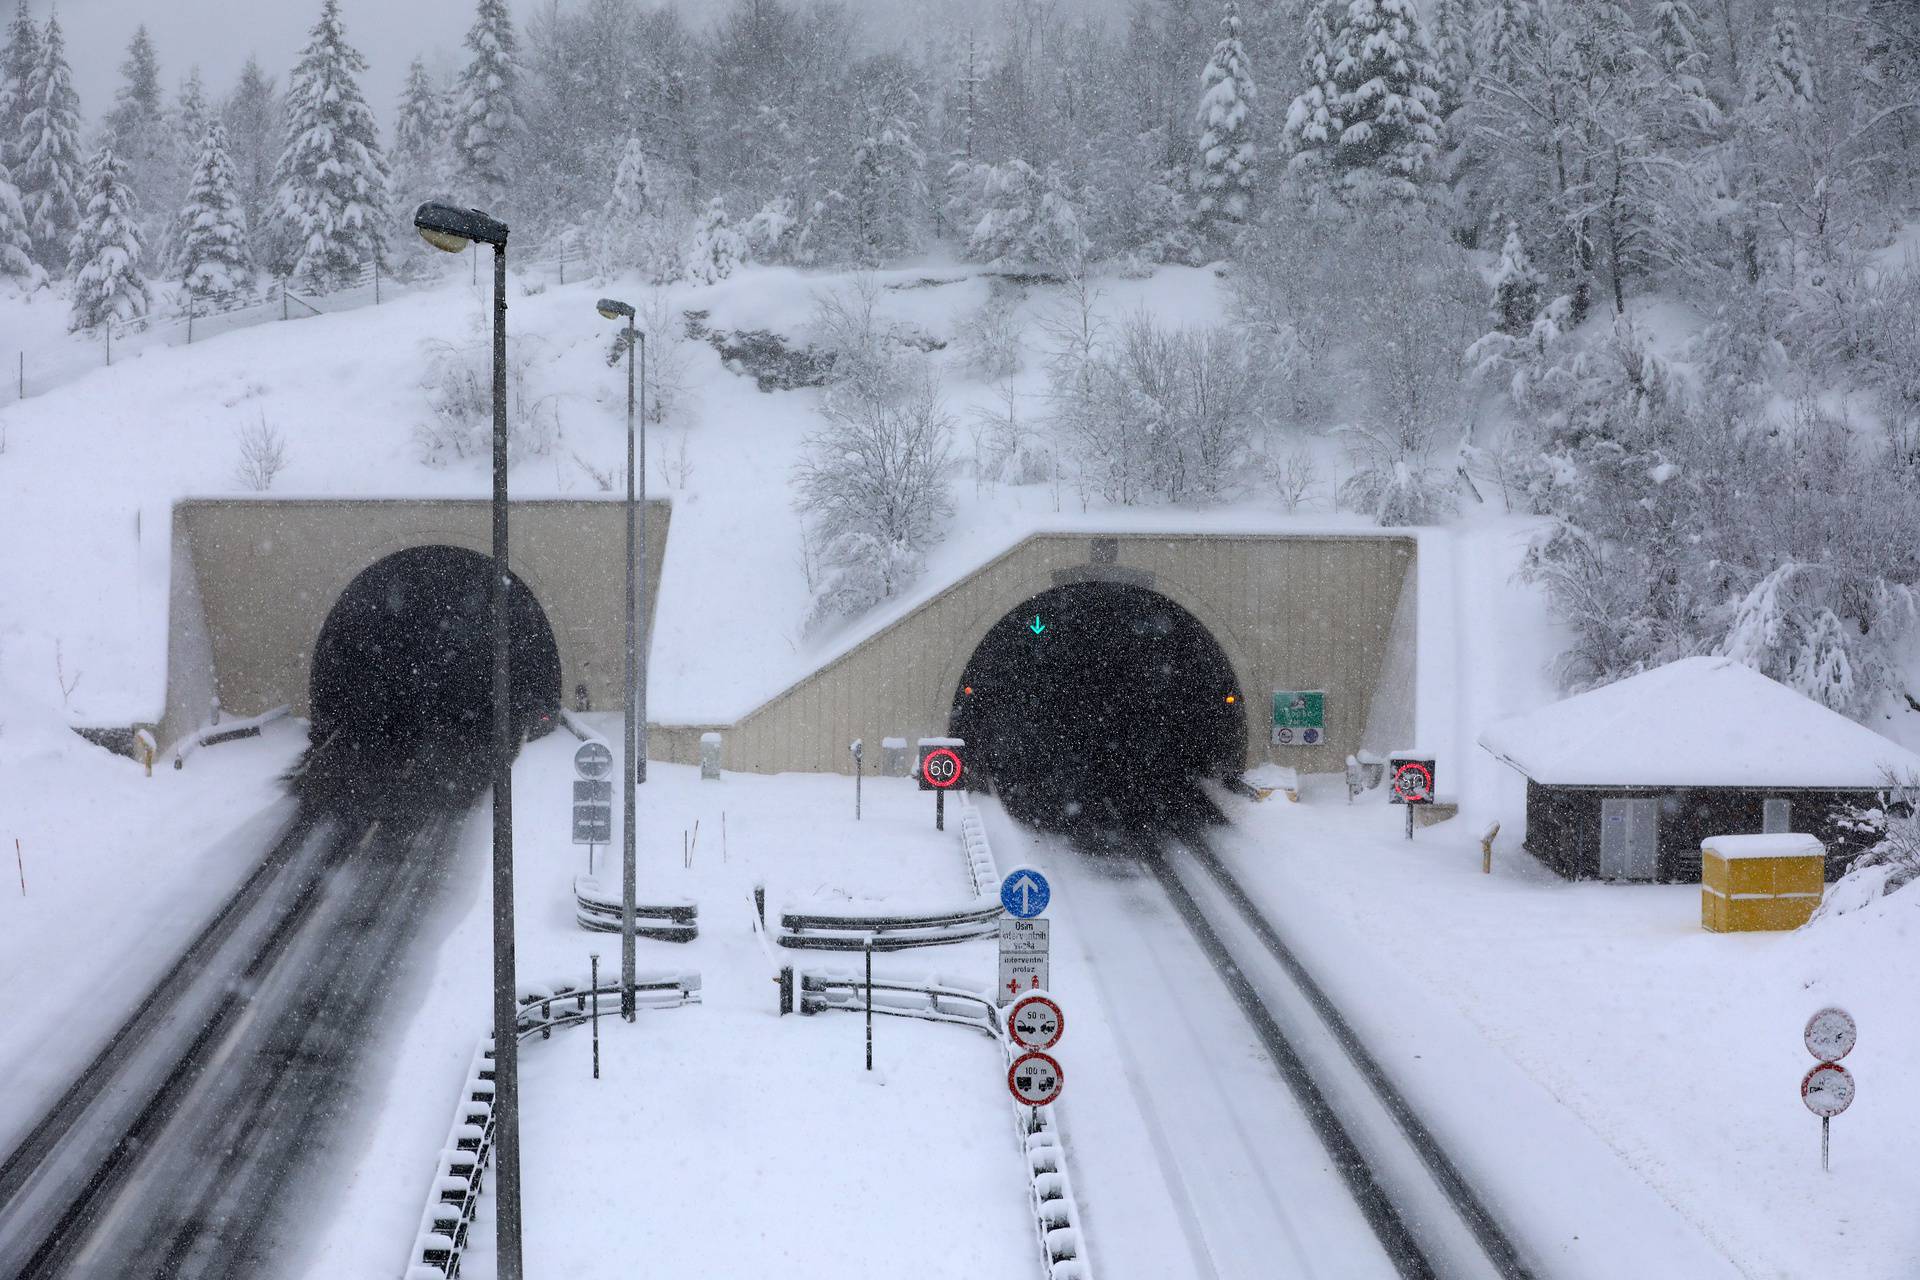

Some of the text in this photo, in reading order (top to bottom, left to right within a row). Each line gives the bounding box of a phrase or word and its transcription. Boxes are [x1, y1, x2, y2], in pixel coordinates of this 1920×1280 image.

[930, 760, 954, 776] 60
[1015, 921, 1034, 930] Osim
[1002, 930, 1046, 940] intervntnih
[1012, 965, 1035, 974] prolaz
[1027, 1011, 1037, 1019] 50
[1025, 1066, 1038, 1075] 100
